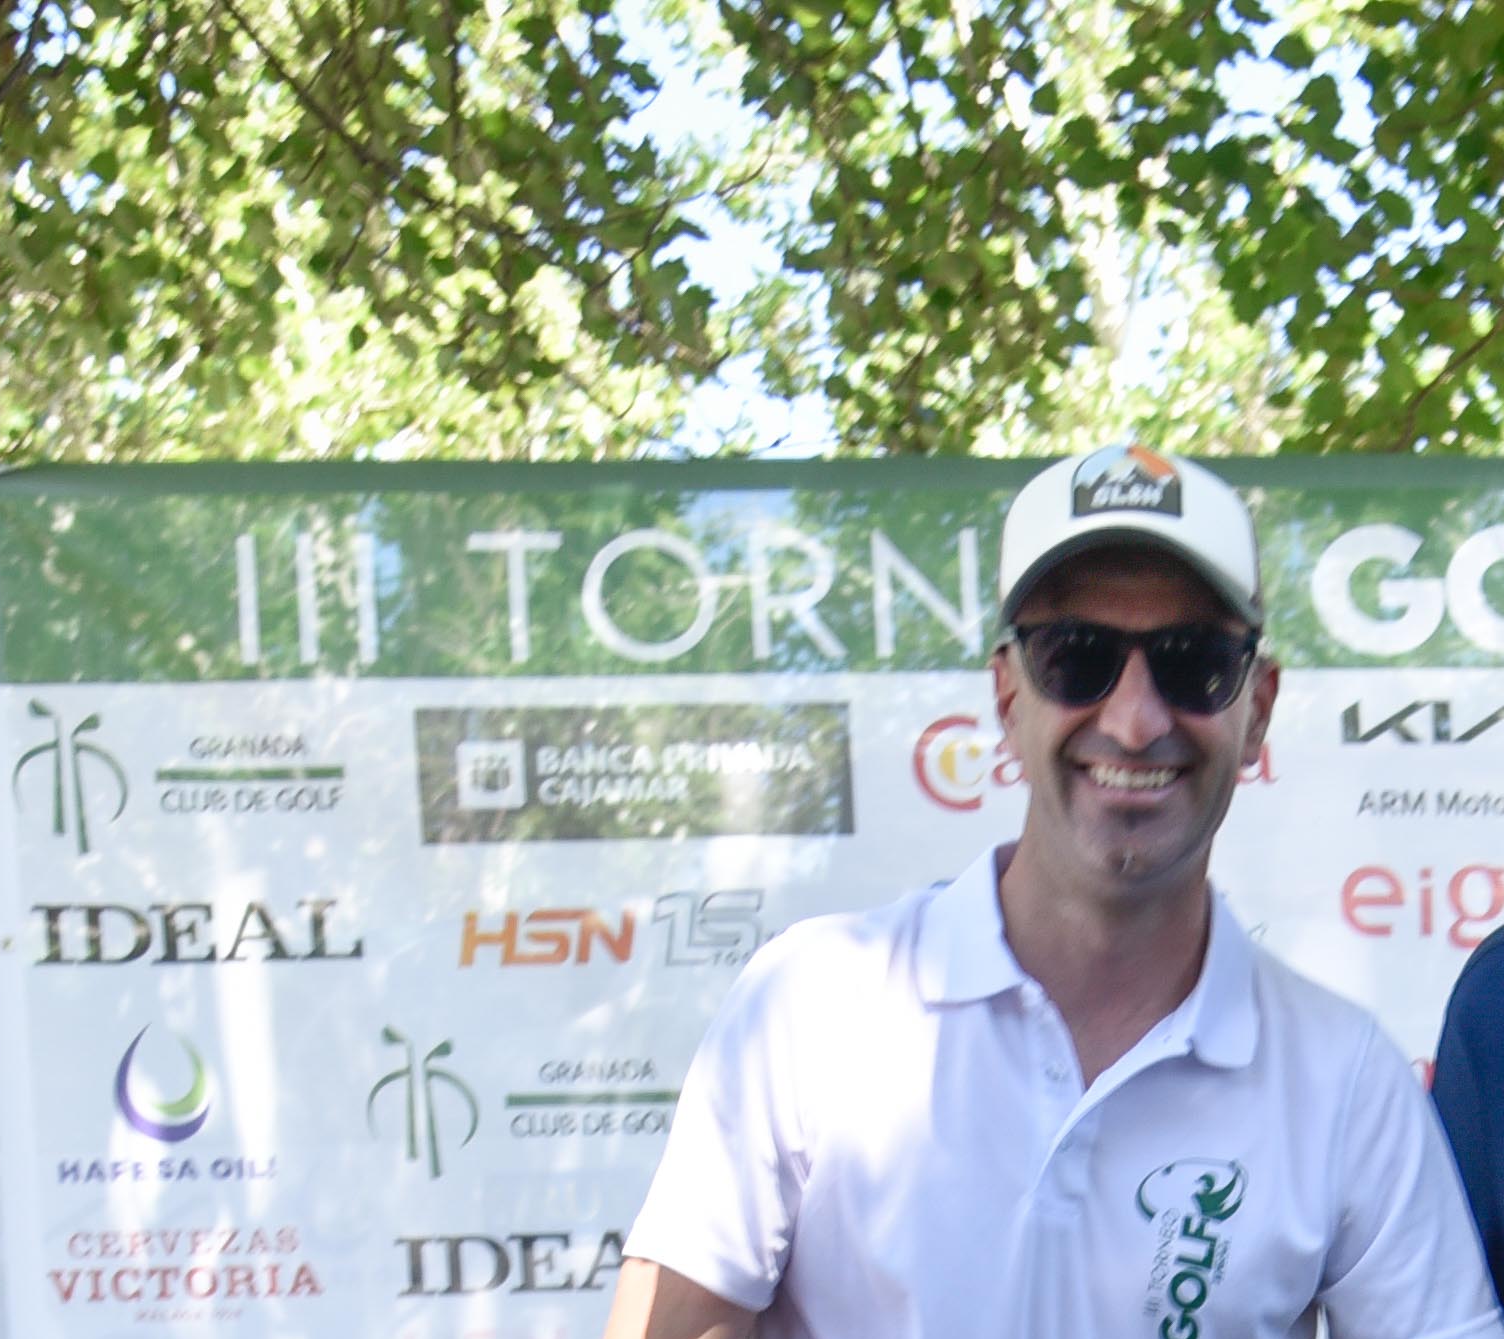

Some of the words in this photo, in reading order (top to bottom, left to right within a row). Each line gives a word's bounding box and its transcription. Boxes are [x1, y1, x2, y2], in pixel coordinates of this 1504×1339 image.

[465, 527, 985, 664] TORN
[188, 733, 308, 759] GRANADA
[535, 744, 652, 776] BANCA
[159, 785, 229, 814] CLUB
[233, 786, 271, 813] DE
[273, 784, 345, 813] GOLF
[1356, 792, 1427, 818] ARM
[30, 900, 364, 968] IDEAL
[458, 906, 635, 969] HSN
[538, 1057, 658, 1085] GRANADA
[509, 1110, 577, 1139] CLUB
[582, 1110, 618, 1137] DE
[66, 1225, 302, 1259] CERVEZAS
[395, 1229, 625, 1298] IDEA
[46, 1261, 326, 1305] VICTORIA
